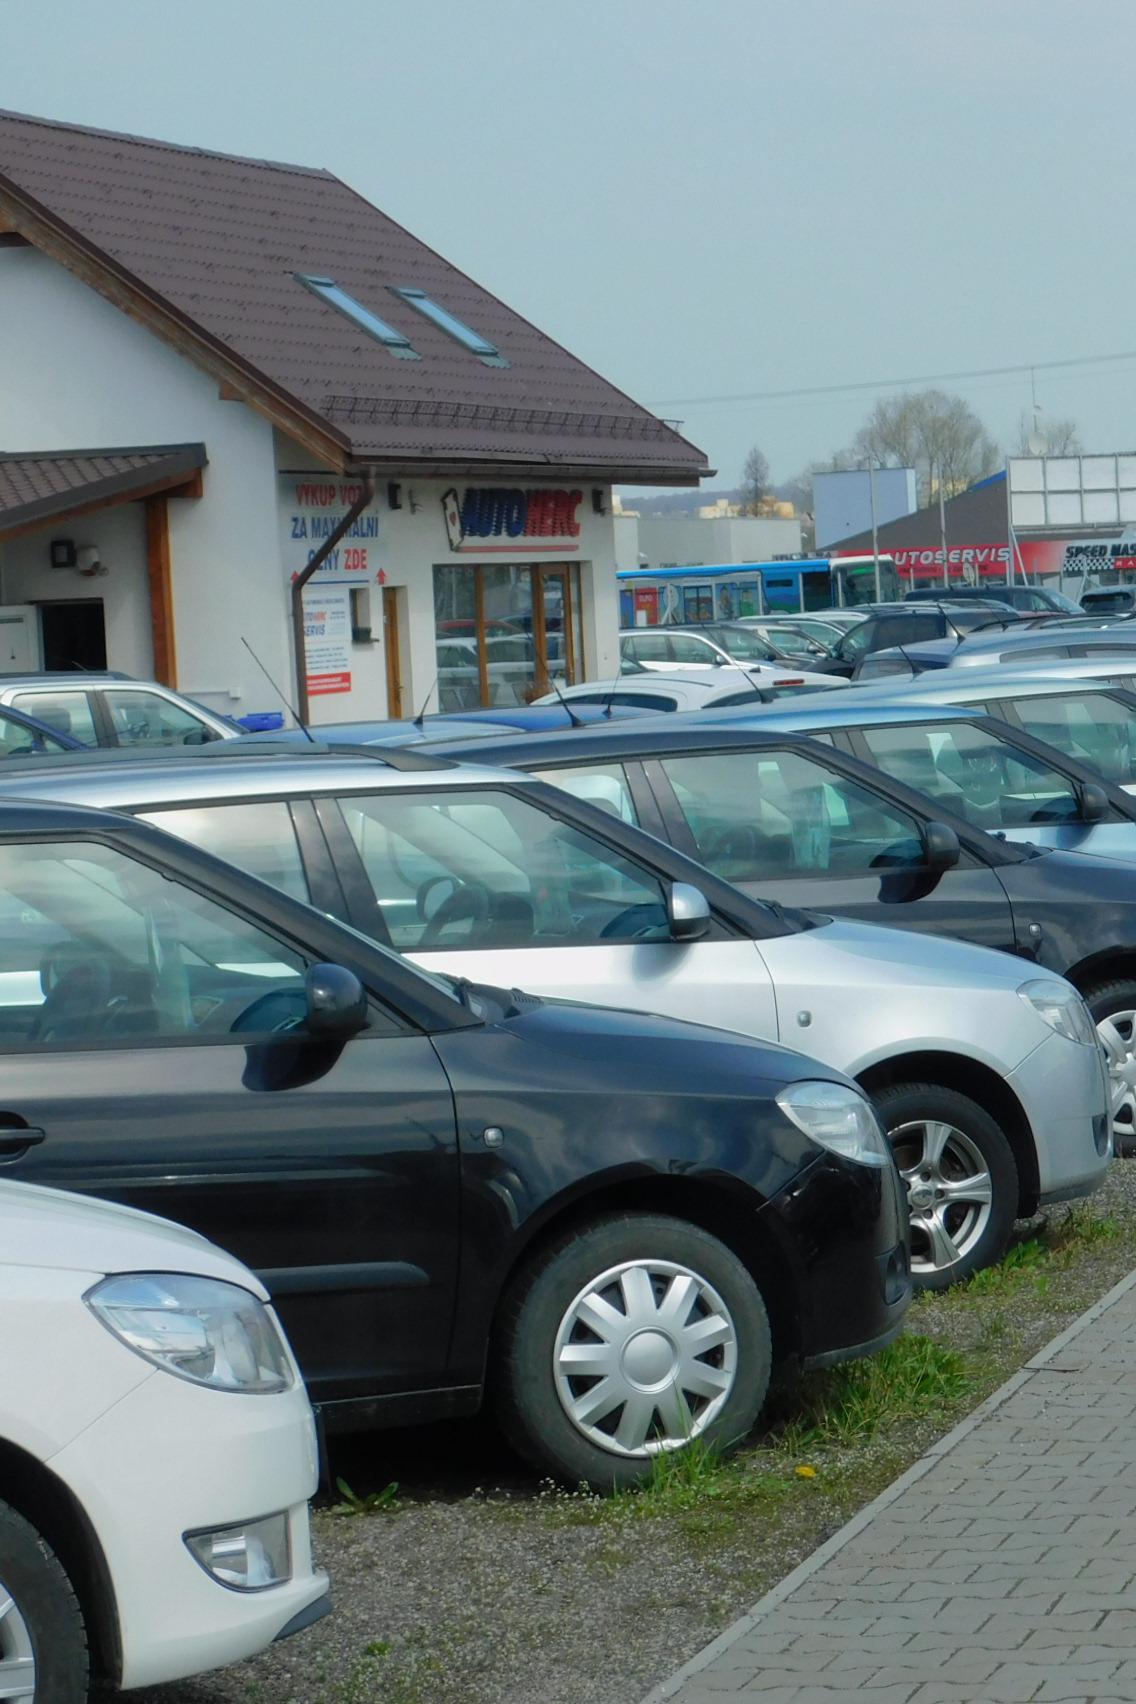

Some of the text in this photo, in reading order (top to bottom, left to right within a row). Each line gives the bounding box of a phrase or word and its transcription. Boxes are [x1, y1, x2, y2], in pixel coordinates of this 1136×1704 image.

[292, 517, 308, 539] ZA
[344, 549, 368, 570] ZDE
[1065, 545, 1107, 558] SPEED
